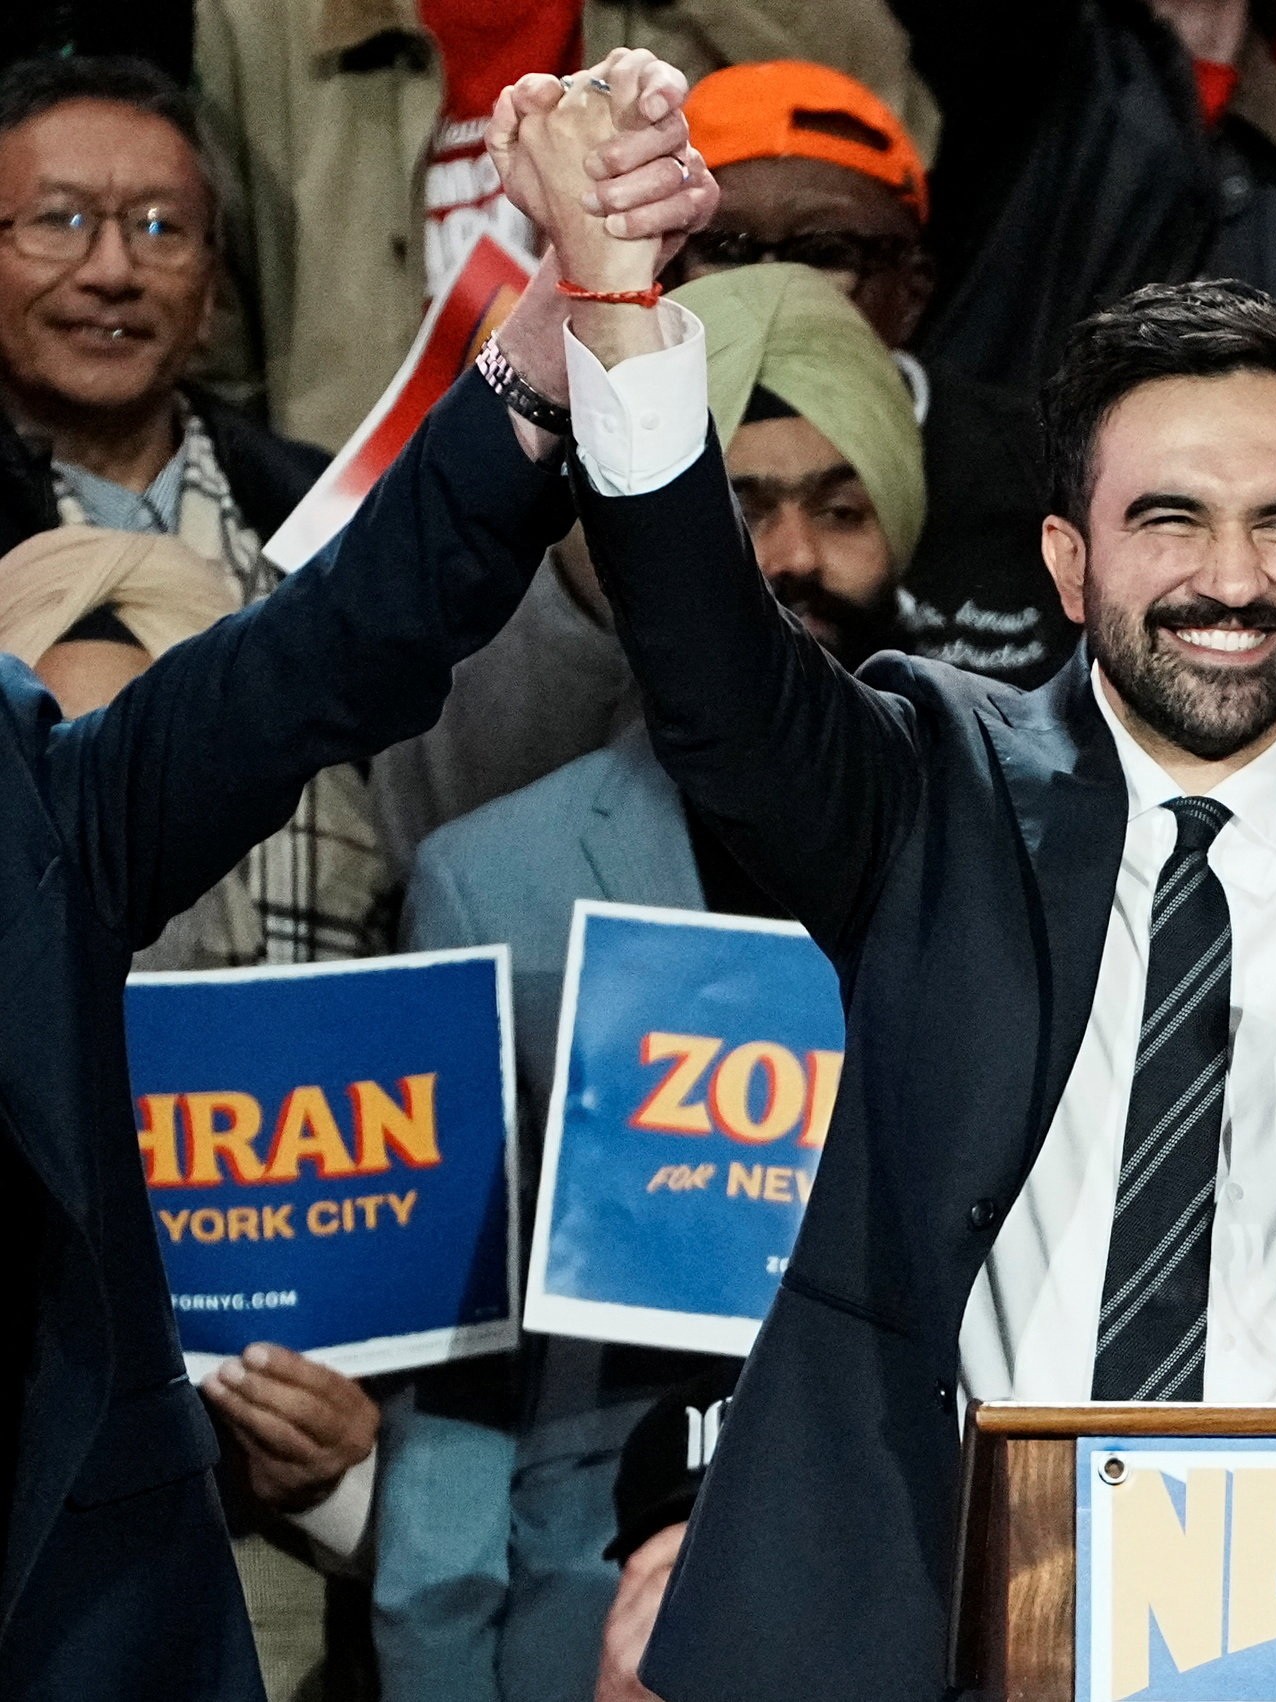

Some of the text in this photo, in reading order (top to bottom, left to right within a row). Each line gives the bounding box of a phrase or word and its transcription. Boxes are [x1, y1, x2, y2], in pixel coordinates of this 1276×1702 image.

[137, 1072, 442, 1188] HRAN
[646, 1161, 717, 1193] FOR
[159, 1189, 418, 1243] YORK CITY
